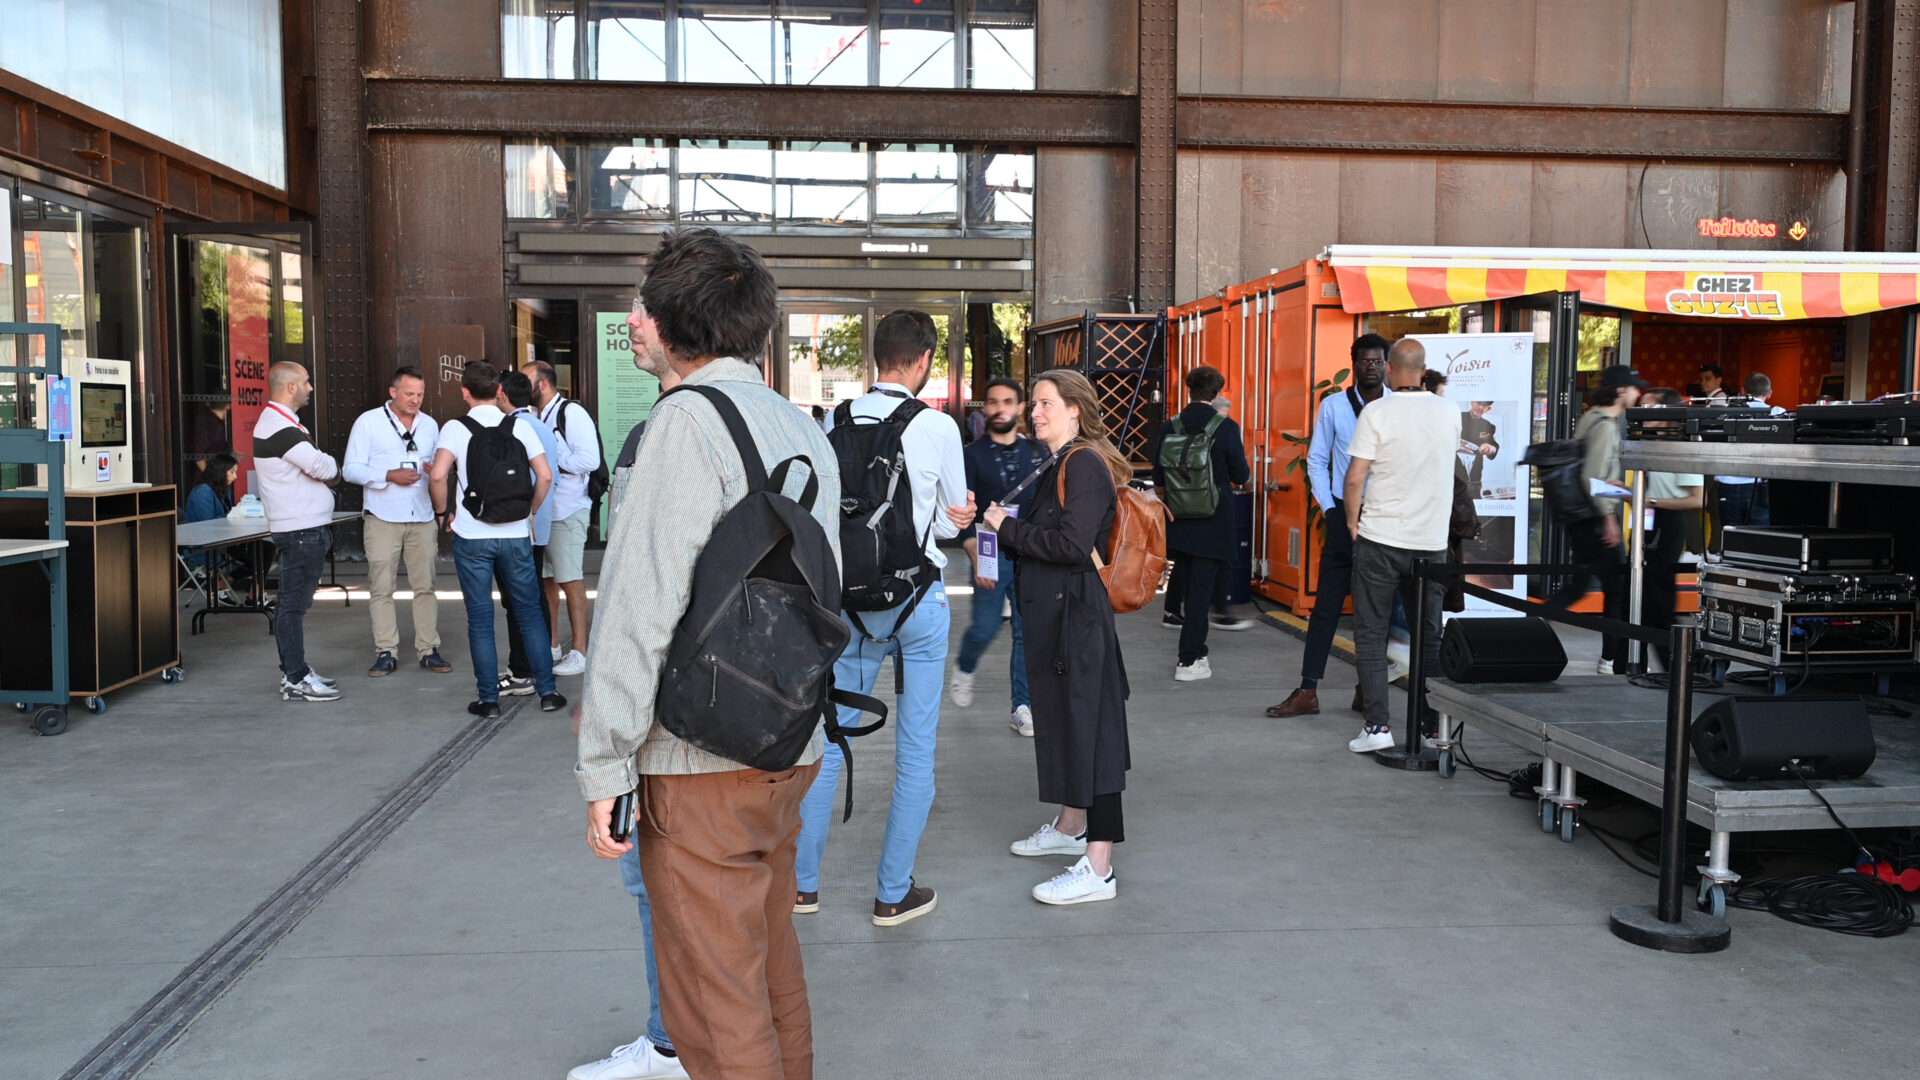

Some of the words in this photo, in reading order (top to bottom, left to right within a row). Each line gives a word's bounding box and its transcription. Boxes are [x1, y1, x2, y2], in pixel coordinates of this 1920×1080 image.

[1697, 216, 1777, 237] Toilettes
[1696, 277, 1751, 293] CHEZ
[606, 339, 631, 351] HO
[235, 356, 265, 380] SCÈNE
[238, 386, 263, 406] HOST
